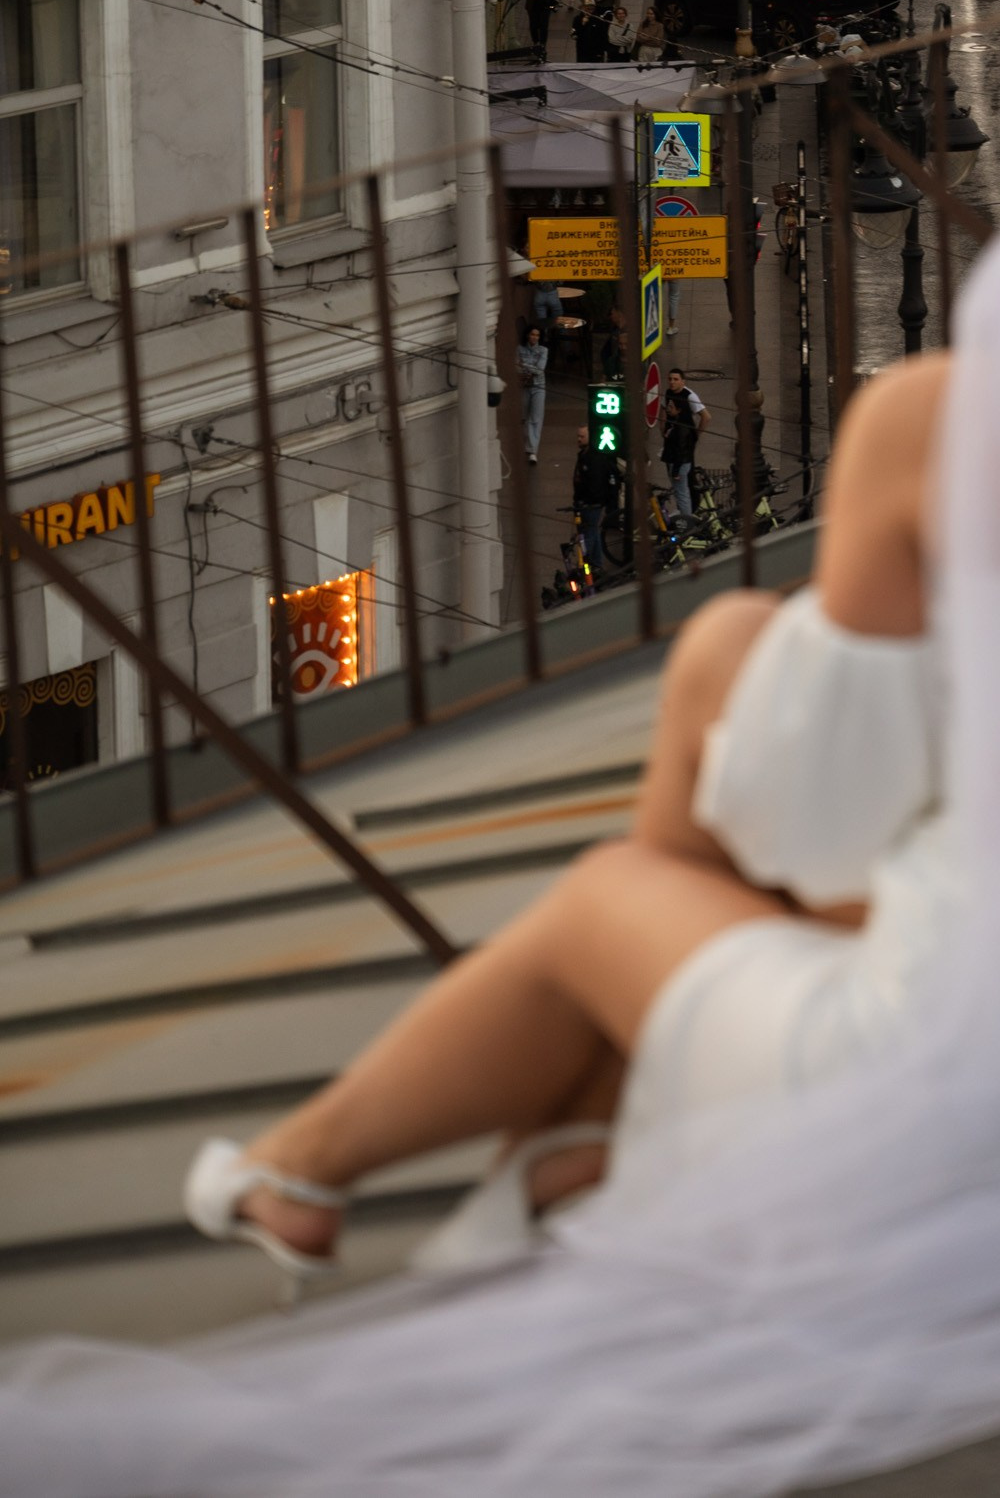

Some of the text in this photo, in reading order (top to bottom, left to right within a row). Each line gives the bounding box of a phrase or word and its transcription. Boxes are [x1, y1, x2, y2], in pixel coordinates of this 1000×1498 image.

[547, 231, 601, 239] ДВИЖЕНИЕ
[570, 259, 613, 267] СУББОТЫ
[664, 267, 684, 275] ДНИ
